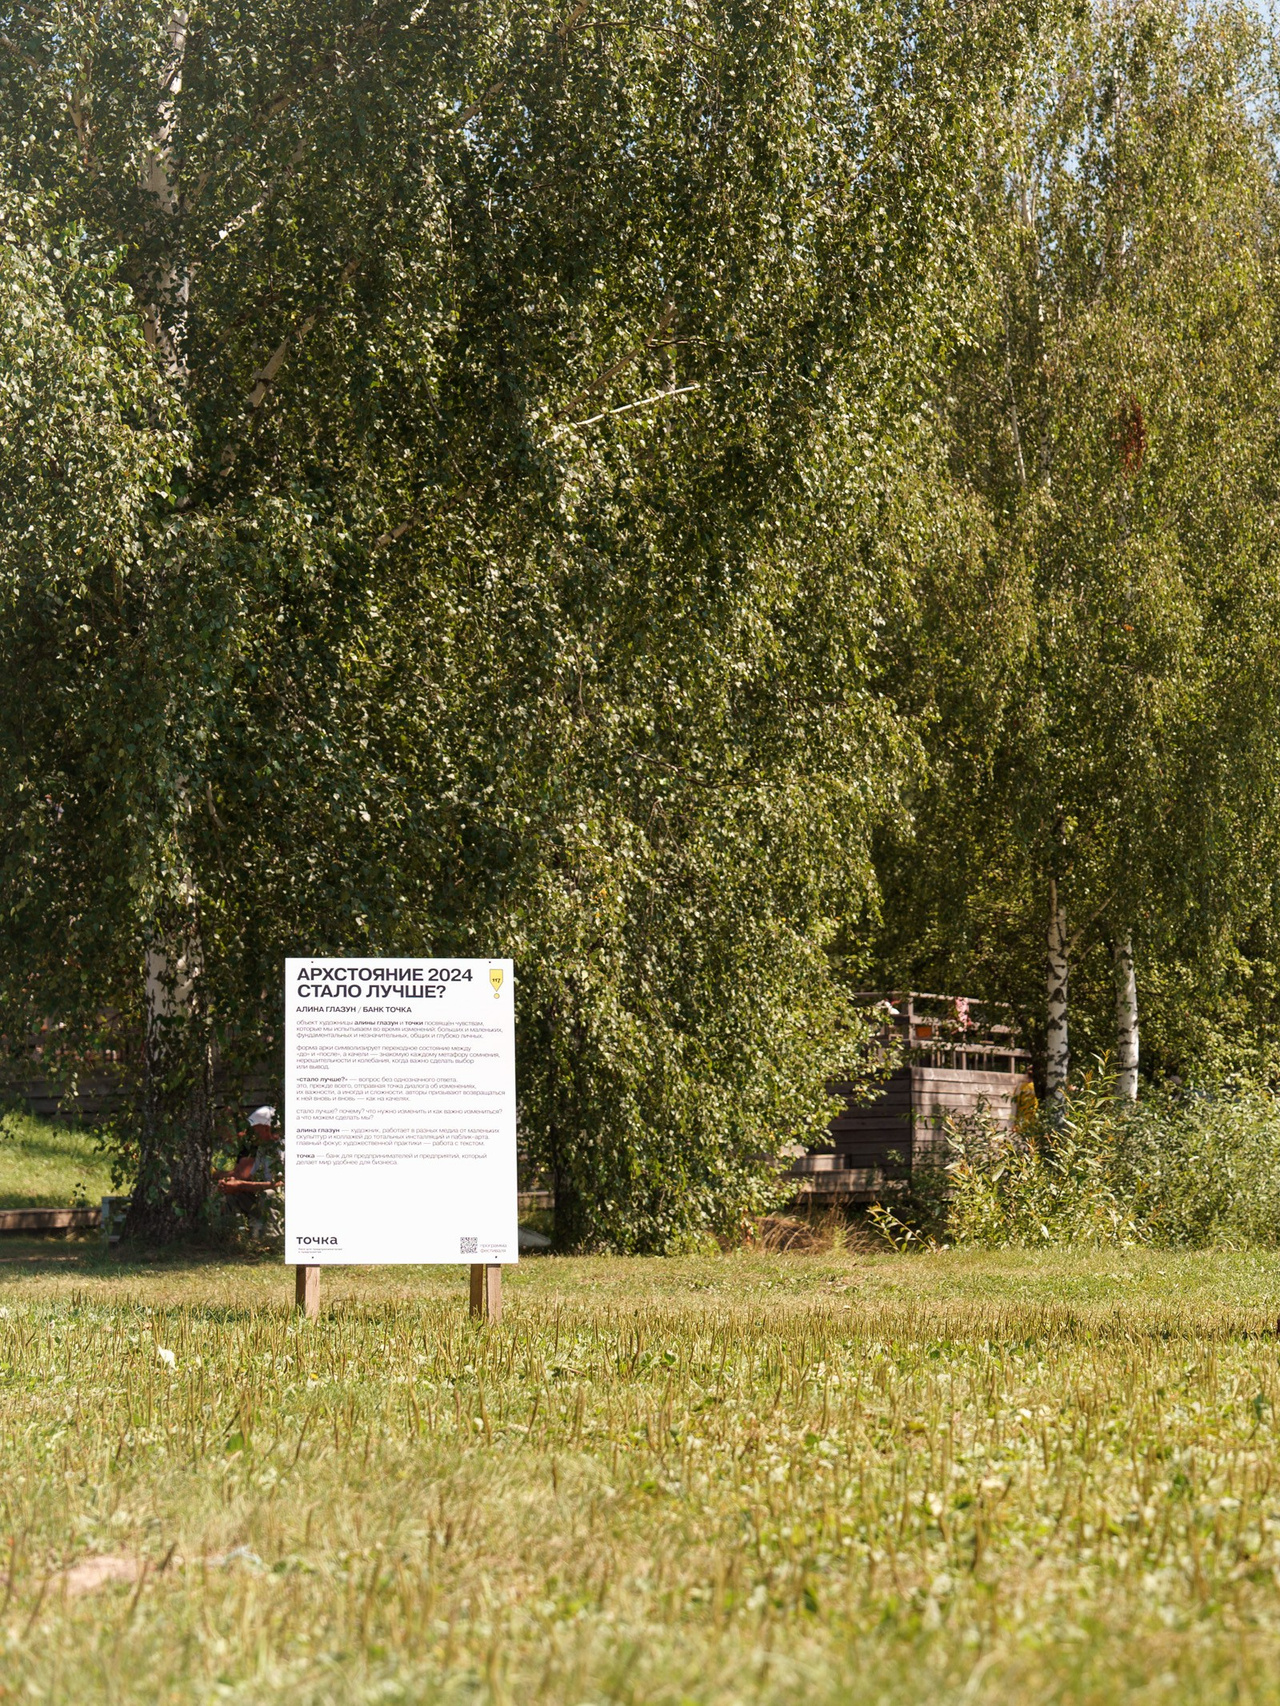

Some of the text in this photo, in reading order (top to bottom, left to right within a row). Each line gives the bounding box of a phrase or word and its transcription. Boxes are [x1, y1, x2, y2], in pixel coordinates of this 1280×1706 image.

[297, 968, 473, 982] АРХСТОЯНИЕ 2024
[297, 984, 446, 998] СТАЛО ЛУЧШЕ?
[296, 1236, 338, 1245] точка
